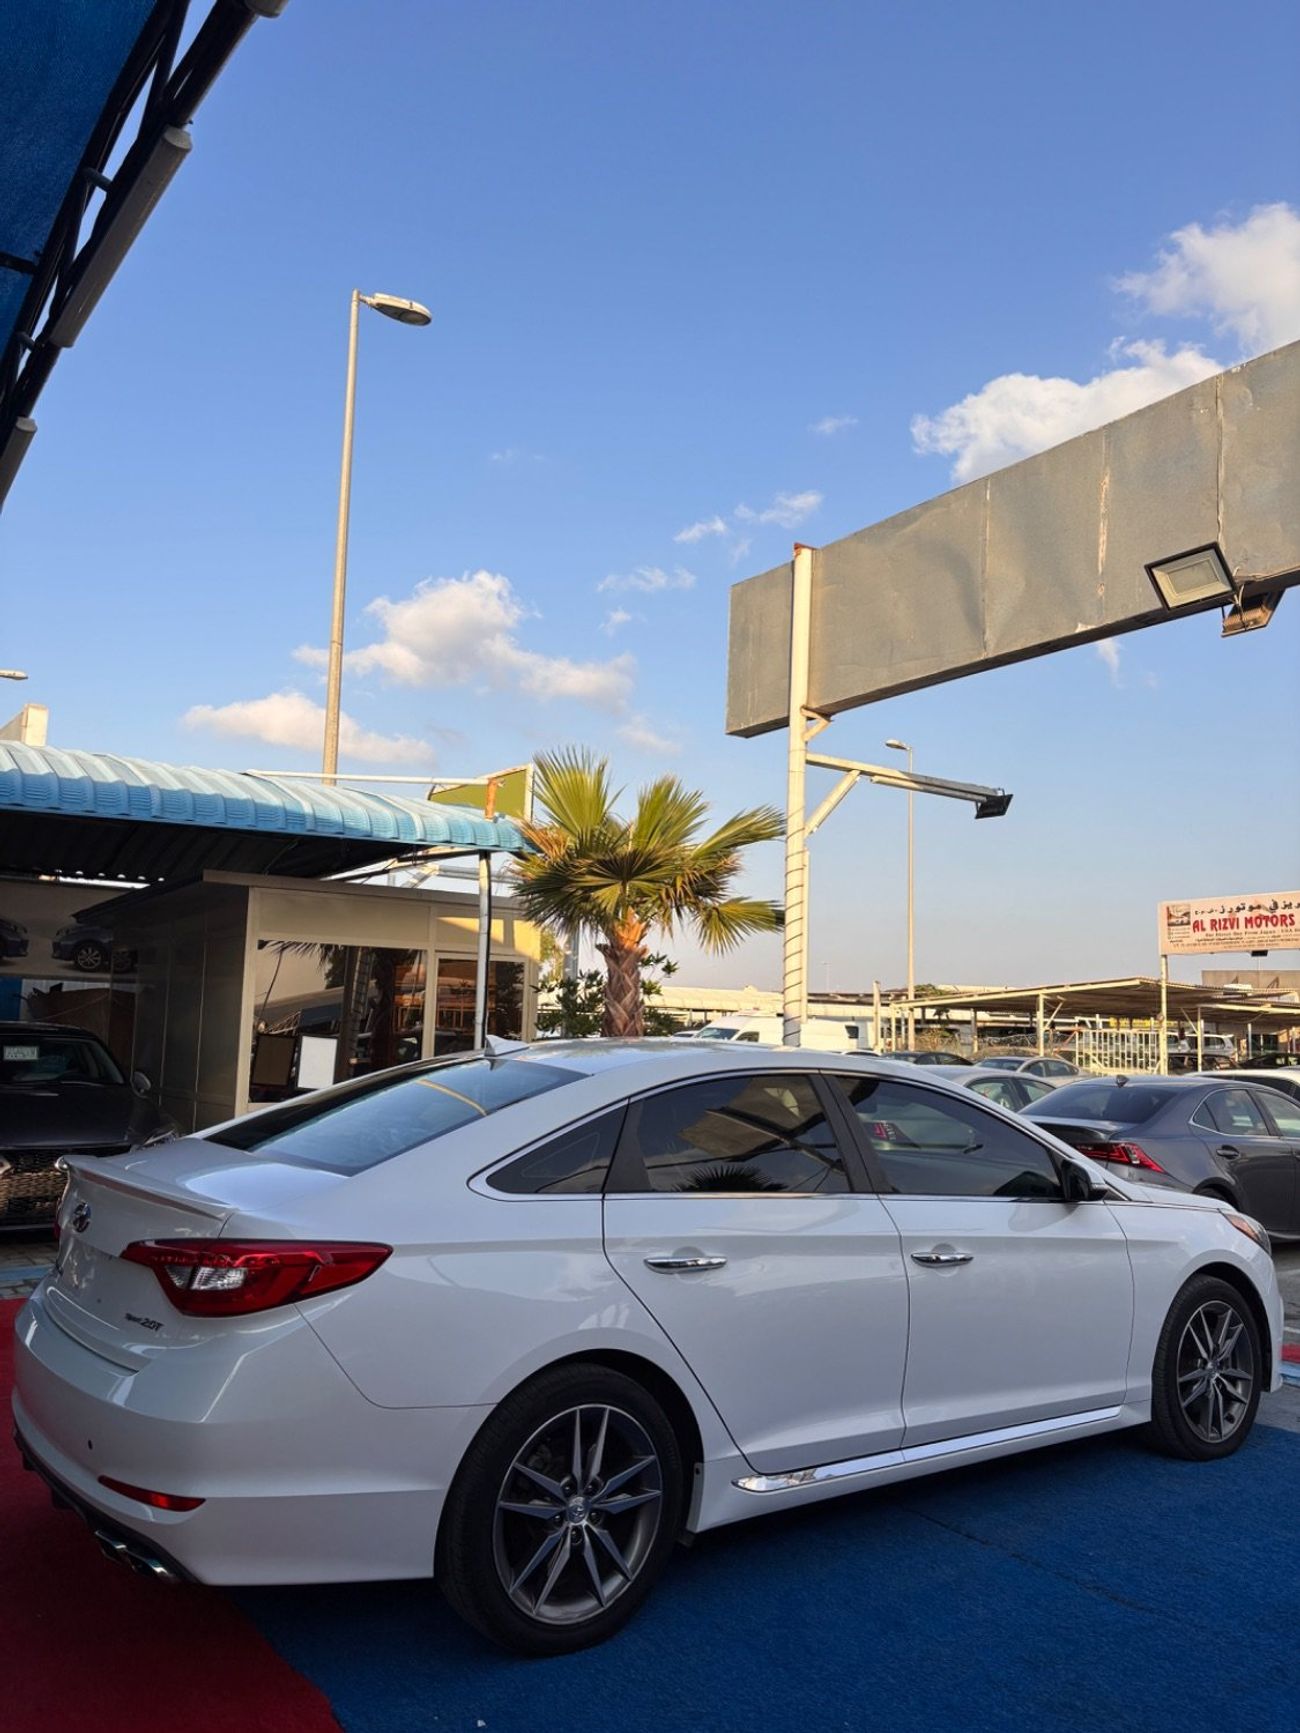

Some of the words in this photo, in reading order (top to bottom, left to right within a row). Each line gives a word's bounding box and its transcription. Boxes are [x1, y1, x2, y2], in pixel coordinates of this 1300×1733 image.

[1192, 919, 1206, 933] AL
[1210, 916, 1240, 932] RIZVI
[1244, 913, 1296, 929] MOTORS
